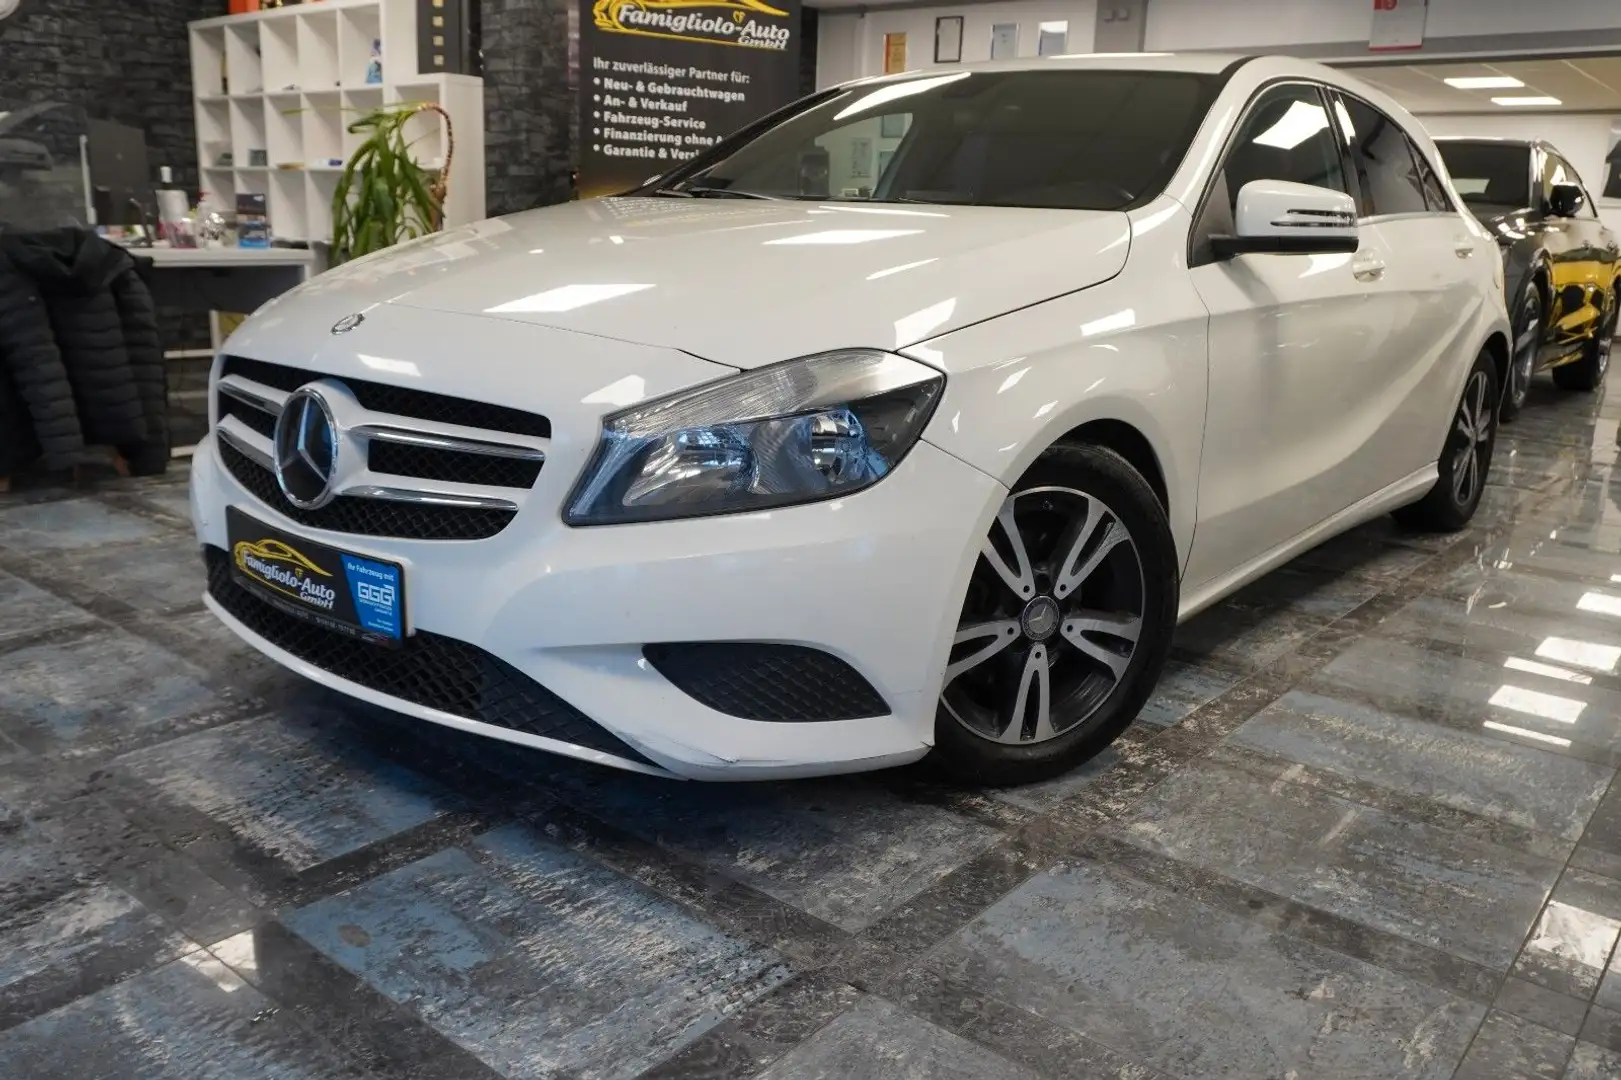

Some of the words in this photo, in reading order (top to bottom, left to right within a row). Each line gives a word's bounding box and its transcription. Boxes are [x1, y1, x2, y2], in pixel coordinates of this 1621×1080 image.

[617, 4, 790, 41] Famigliolo-Auto
[737, 36, 787, 50] GmbH
[593, 57, 610, 70] Ihr
[612, 61, 687, 80] zuverlässiger
[689, 67, 729, 82] Partner
[730, 70, 750, 84] für:
[603, 77, 633, 92] Neu-
[635, 80, 645, 93] &
[647, 81, 745, 102] Gebrauchtwagen
[603, 95, 625, 107] An-
[628, 96, 638, 109] &
[640, 97, 688, 112] Verkauf
[603, 111, 707, 130] Fahrzeug-Service
[603, 128, 683, 146] Finanzierung
[684, 132, 714, 147] ohne
[603, 144, 656, 158] Garantie
[658, 146, 668, 159] &
[242, 550, 336, 602] Famigliolo-Auto
[300, 591, 334, 610] GmbH
